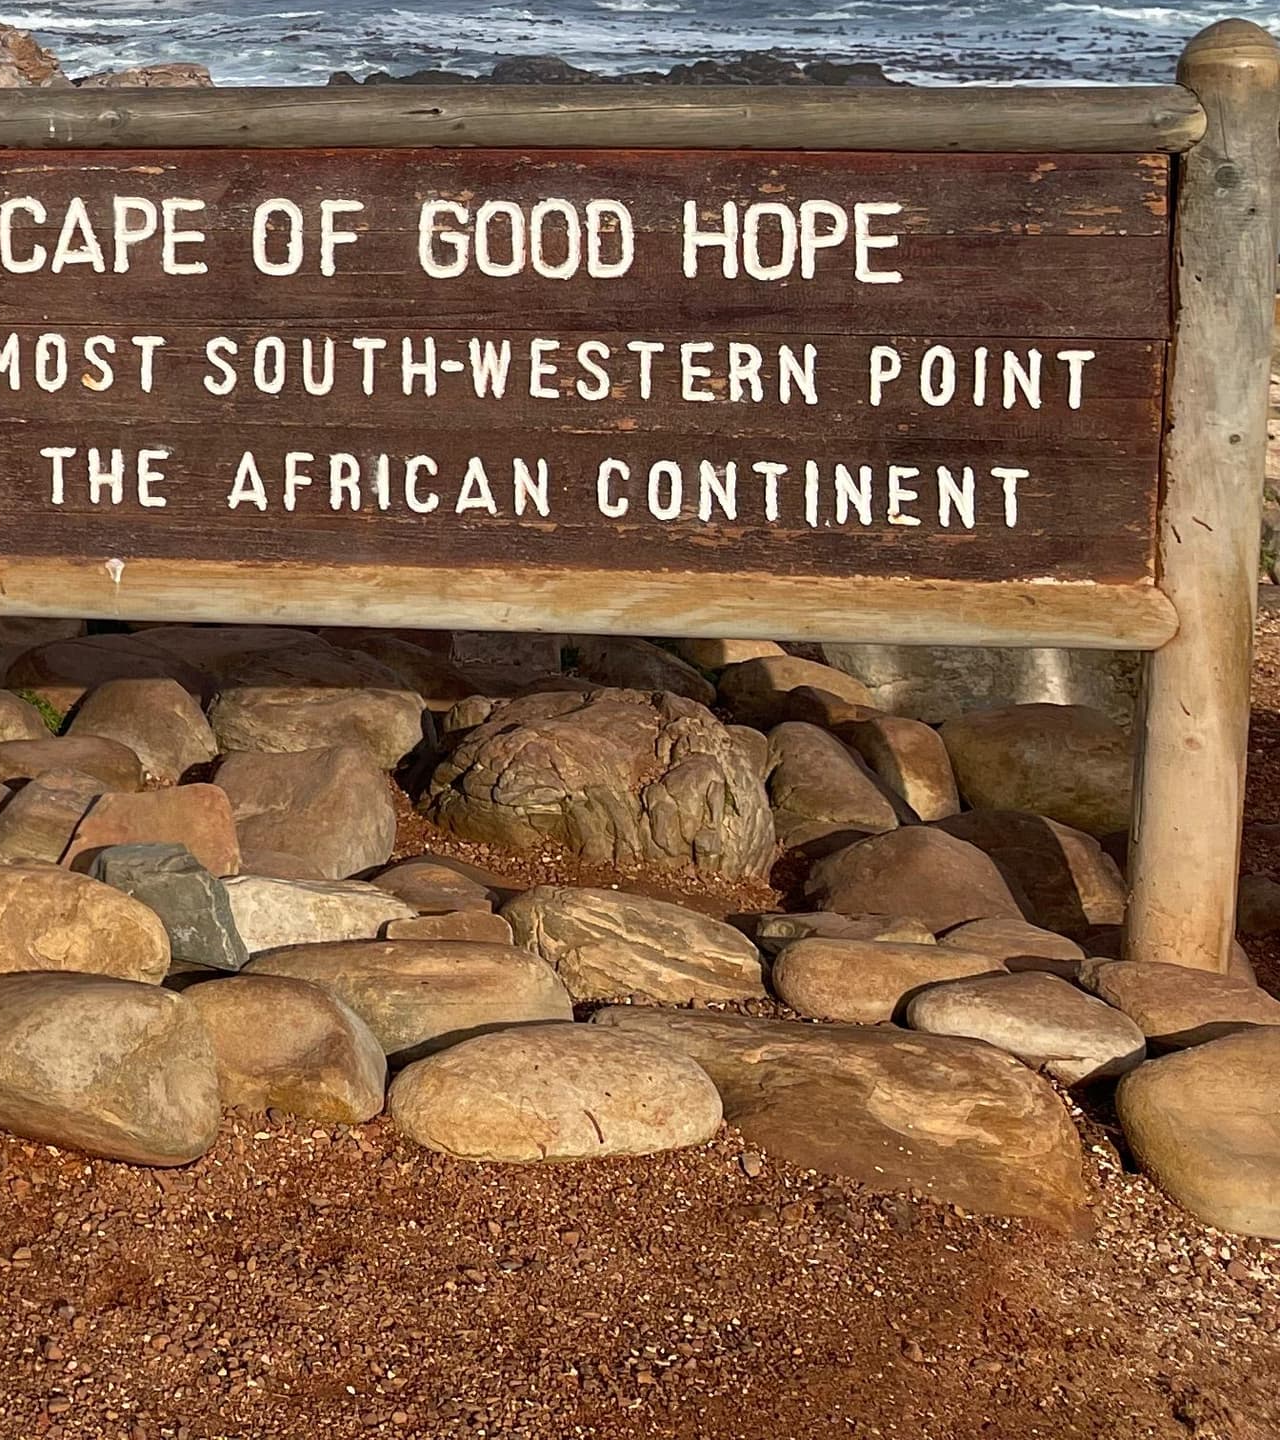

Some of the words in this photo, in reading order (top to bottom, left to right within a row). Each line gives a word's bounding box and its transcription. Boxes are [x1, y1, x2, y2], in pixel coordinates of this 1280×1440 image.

[251, 196, 366, 278] OF
[417, 196, 636, 282] GOOD
[682, 198, 904, 285] HOPE
[202, 335, 819, 406] SOUTH-WESTERN
[869, 344, 1096, 411] POINT
[38, 445, 171, 508] THE
[226, 450, 551, 518] AFRICAN
[596, 456, 1030, 530] CONTINENT
